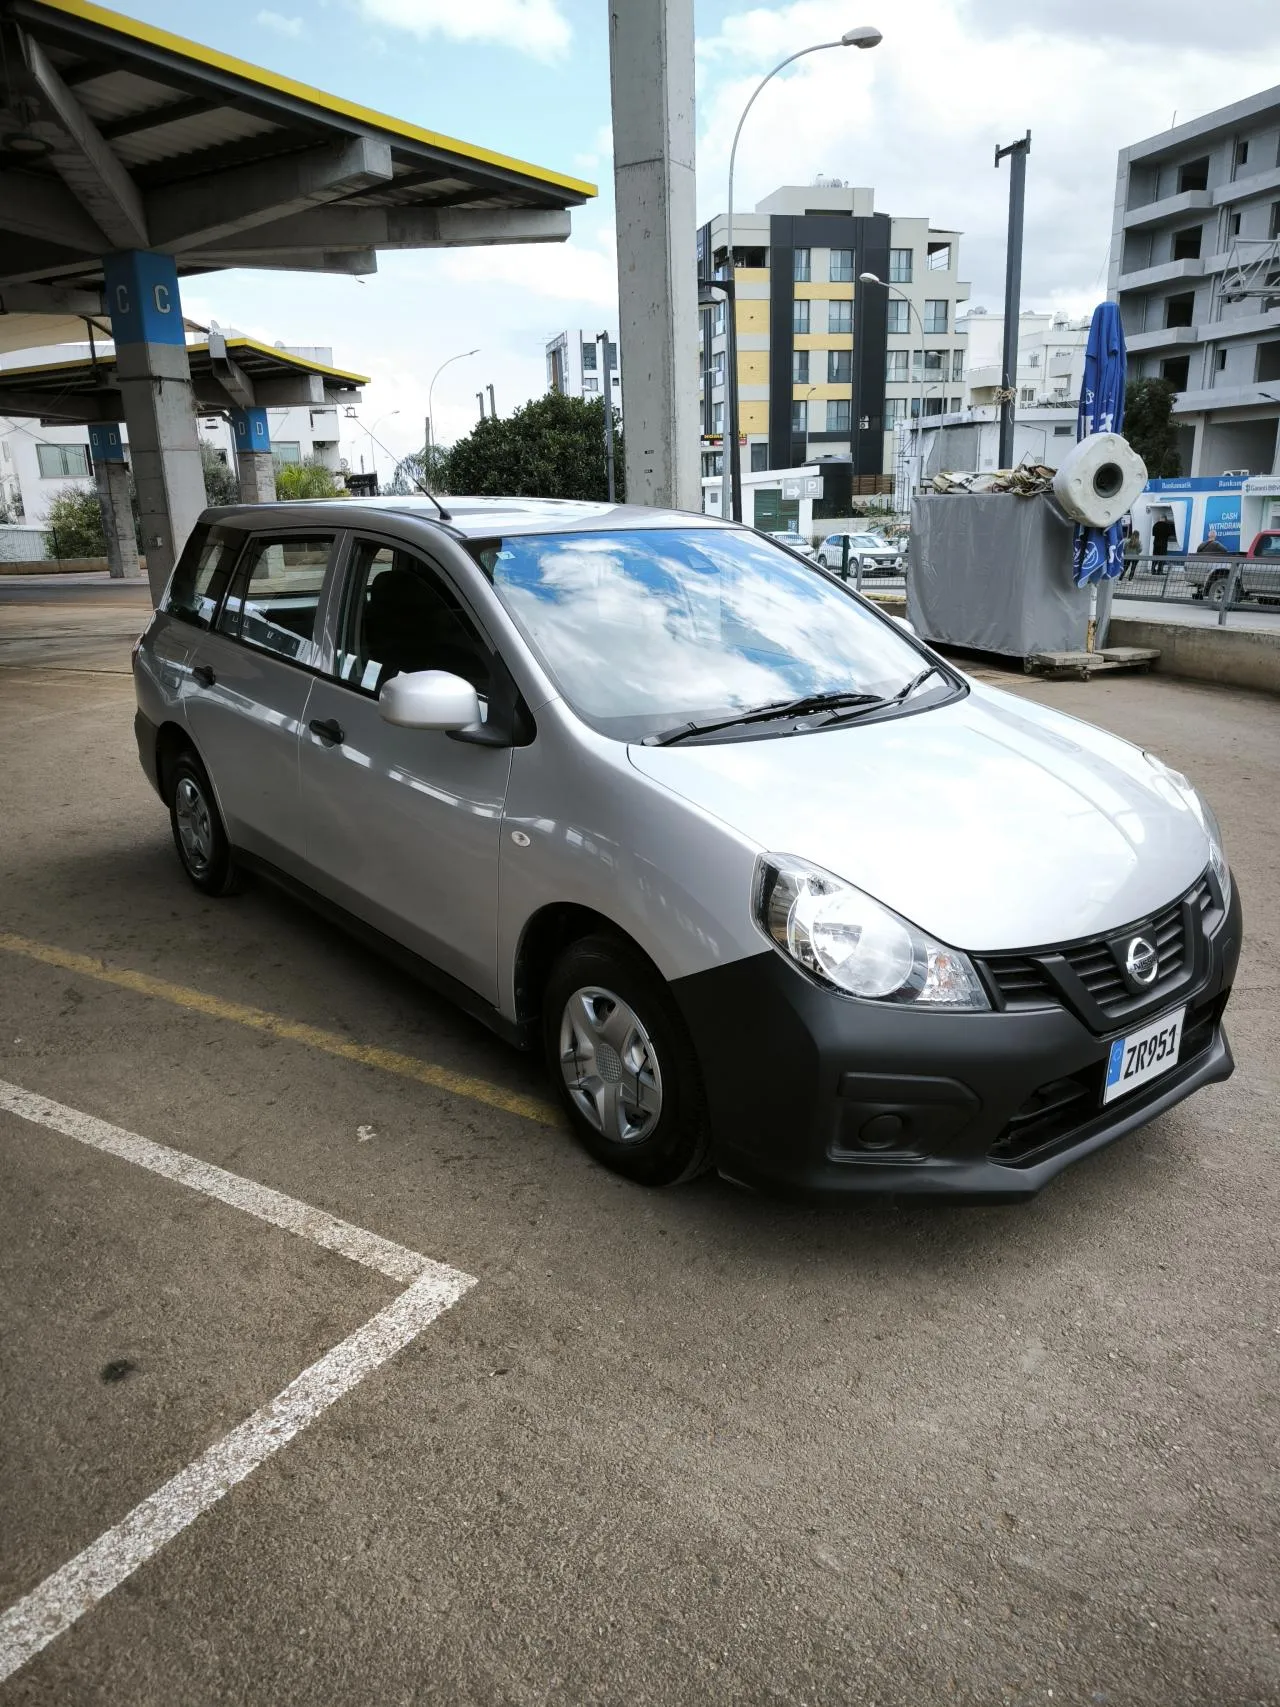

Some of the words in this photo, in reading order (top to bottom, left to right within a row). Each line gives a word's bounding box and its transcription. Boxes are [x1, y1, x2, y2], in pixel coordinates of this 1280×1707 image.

[116, 285, 130, 314] C
[154, 285, 171, 314] C
[807, 480, 817, 492] P
[1221, 512, 1238, 520] CASH
[1133, 954, 1156, 971] NISS
[1124, 1024, 1177, 1080] ZR951
